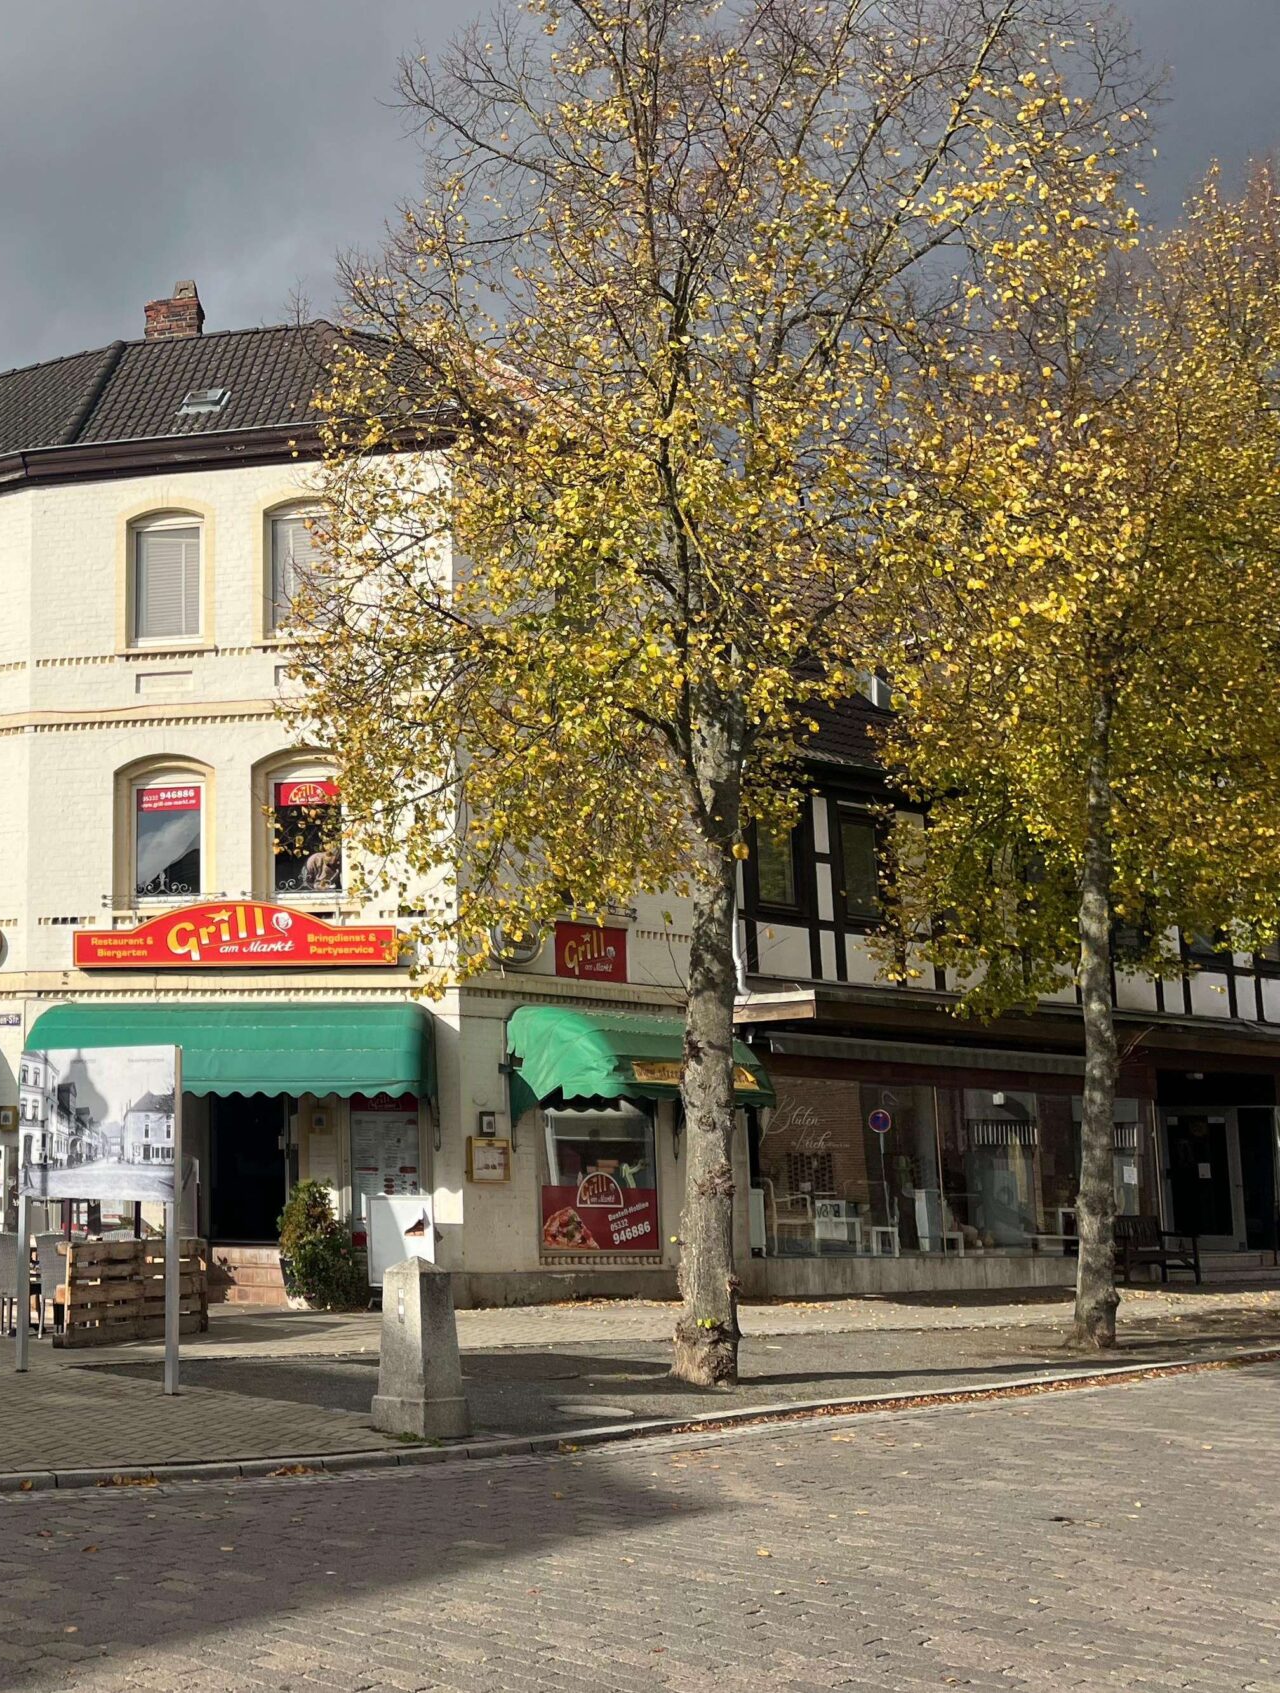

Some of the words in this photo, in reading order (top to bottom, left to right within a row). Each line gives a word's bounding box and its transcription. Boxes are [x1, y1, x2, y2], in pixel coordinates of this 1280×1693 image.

[160, 789, 195, 800] 946886
[167, 904, 265, 961] Grill
[307, 933, 366, 945] Bringdienst
[368, 932, 377, 942] &
[91, 937, 144, 946] Restaurant
[146, 936, 154, 945] &
[220, 945, 239, 954] am
[243, 939, 296, 953] Markt
[97, 948, 148, 959] Biergarten
[309, 945, 375, 956] Partyservice
[564, 929, 605, 976] Grill
[580, 1174, 607, 1205] Grill
[610, 1218, 629, 1232] 05332
[612, 1221, 651, 1245] 946886
